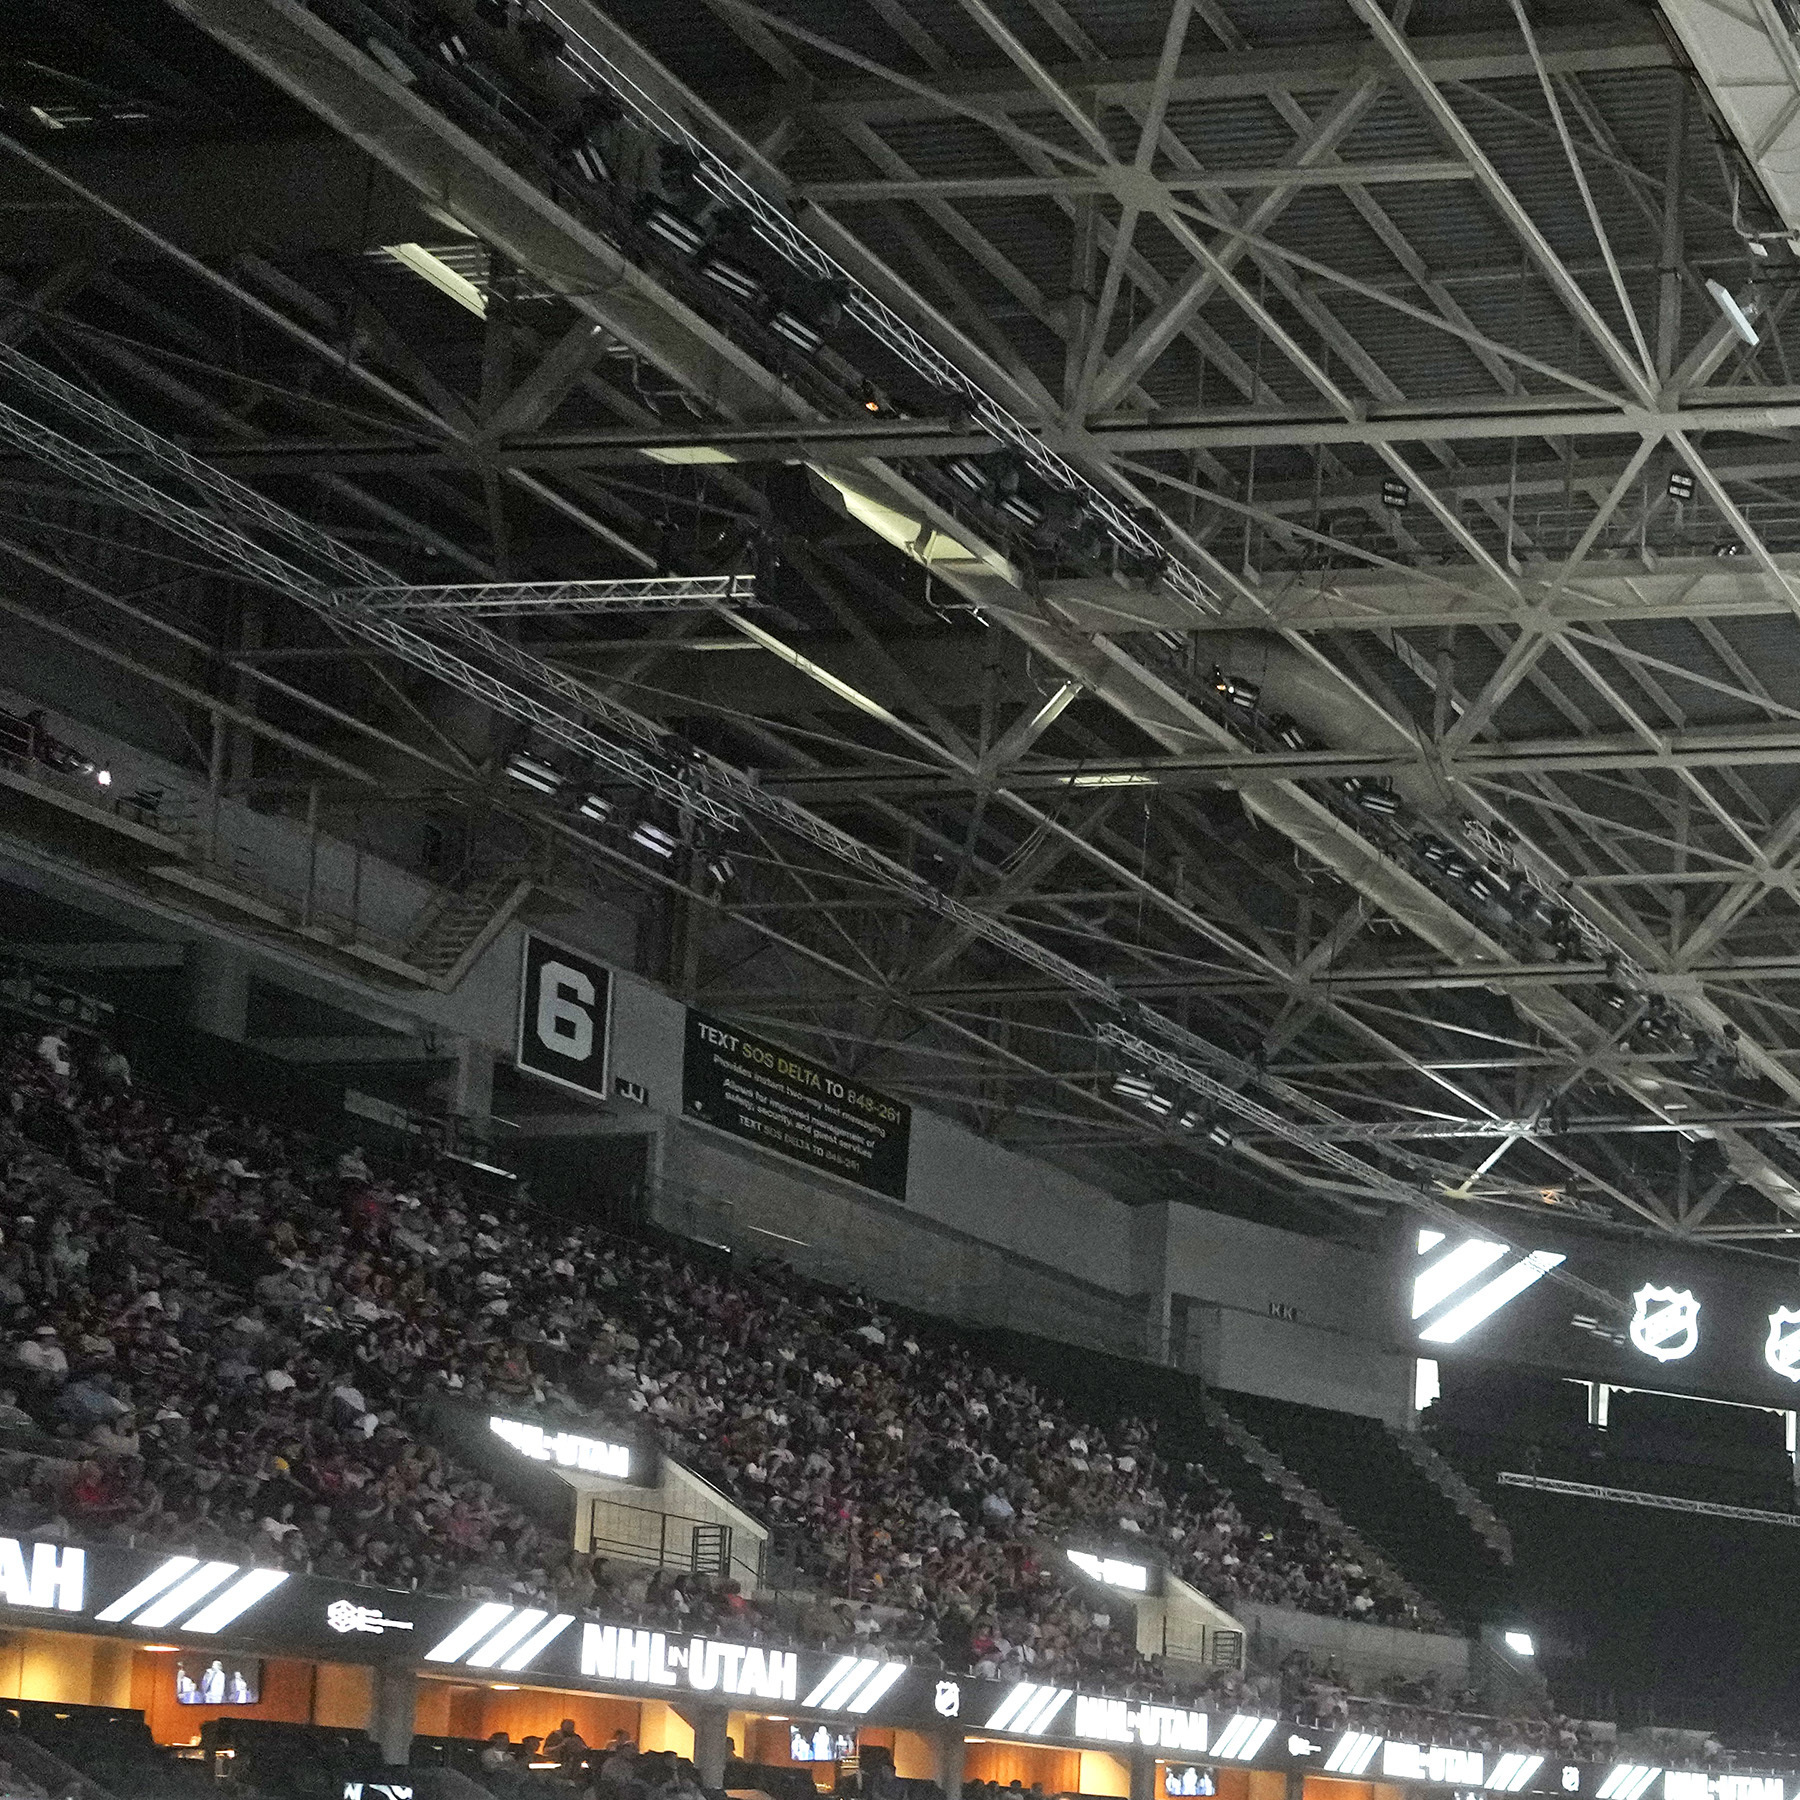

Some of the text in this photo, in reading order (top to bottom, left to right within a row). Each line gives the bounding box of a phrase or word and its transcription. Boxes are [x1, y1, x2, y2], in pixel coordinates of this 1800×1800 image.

[537, 959, 595, 1061] 6
[698, 1022, 740, 1051] TEXT
[742, 1043, 774, 1068] SOS
[778, 1059, 822, 1090] DELTA
[825, 1079, 844, 1098] TO
[582, 1623, 797, 1700] NHL IN UTAH
[1139, 1704, 1208, 1752] UTAH
